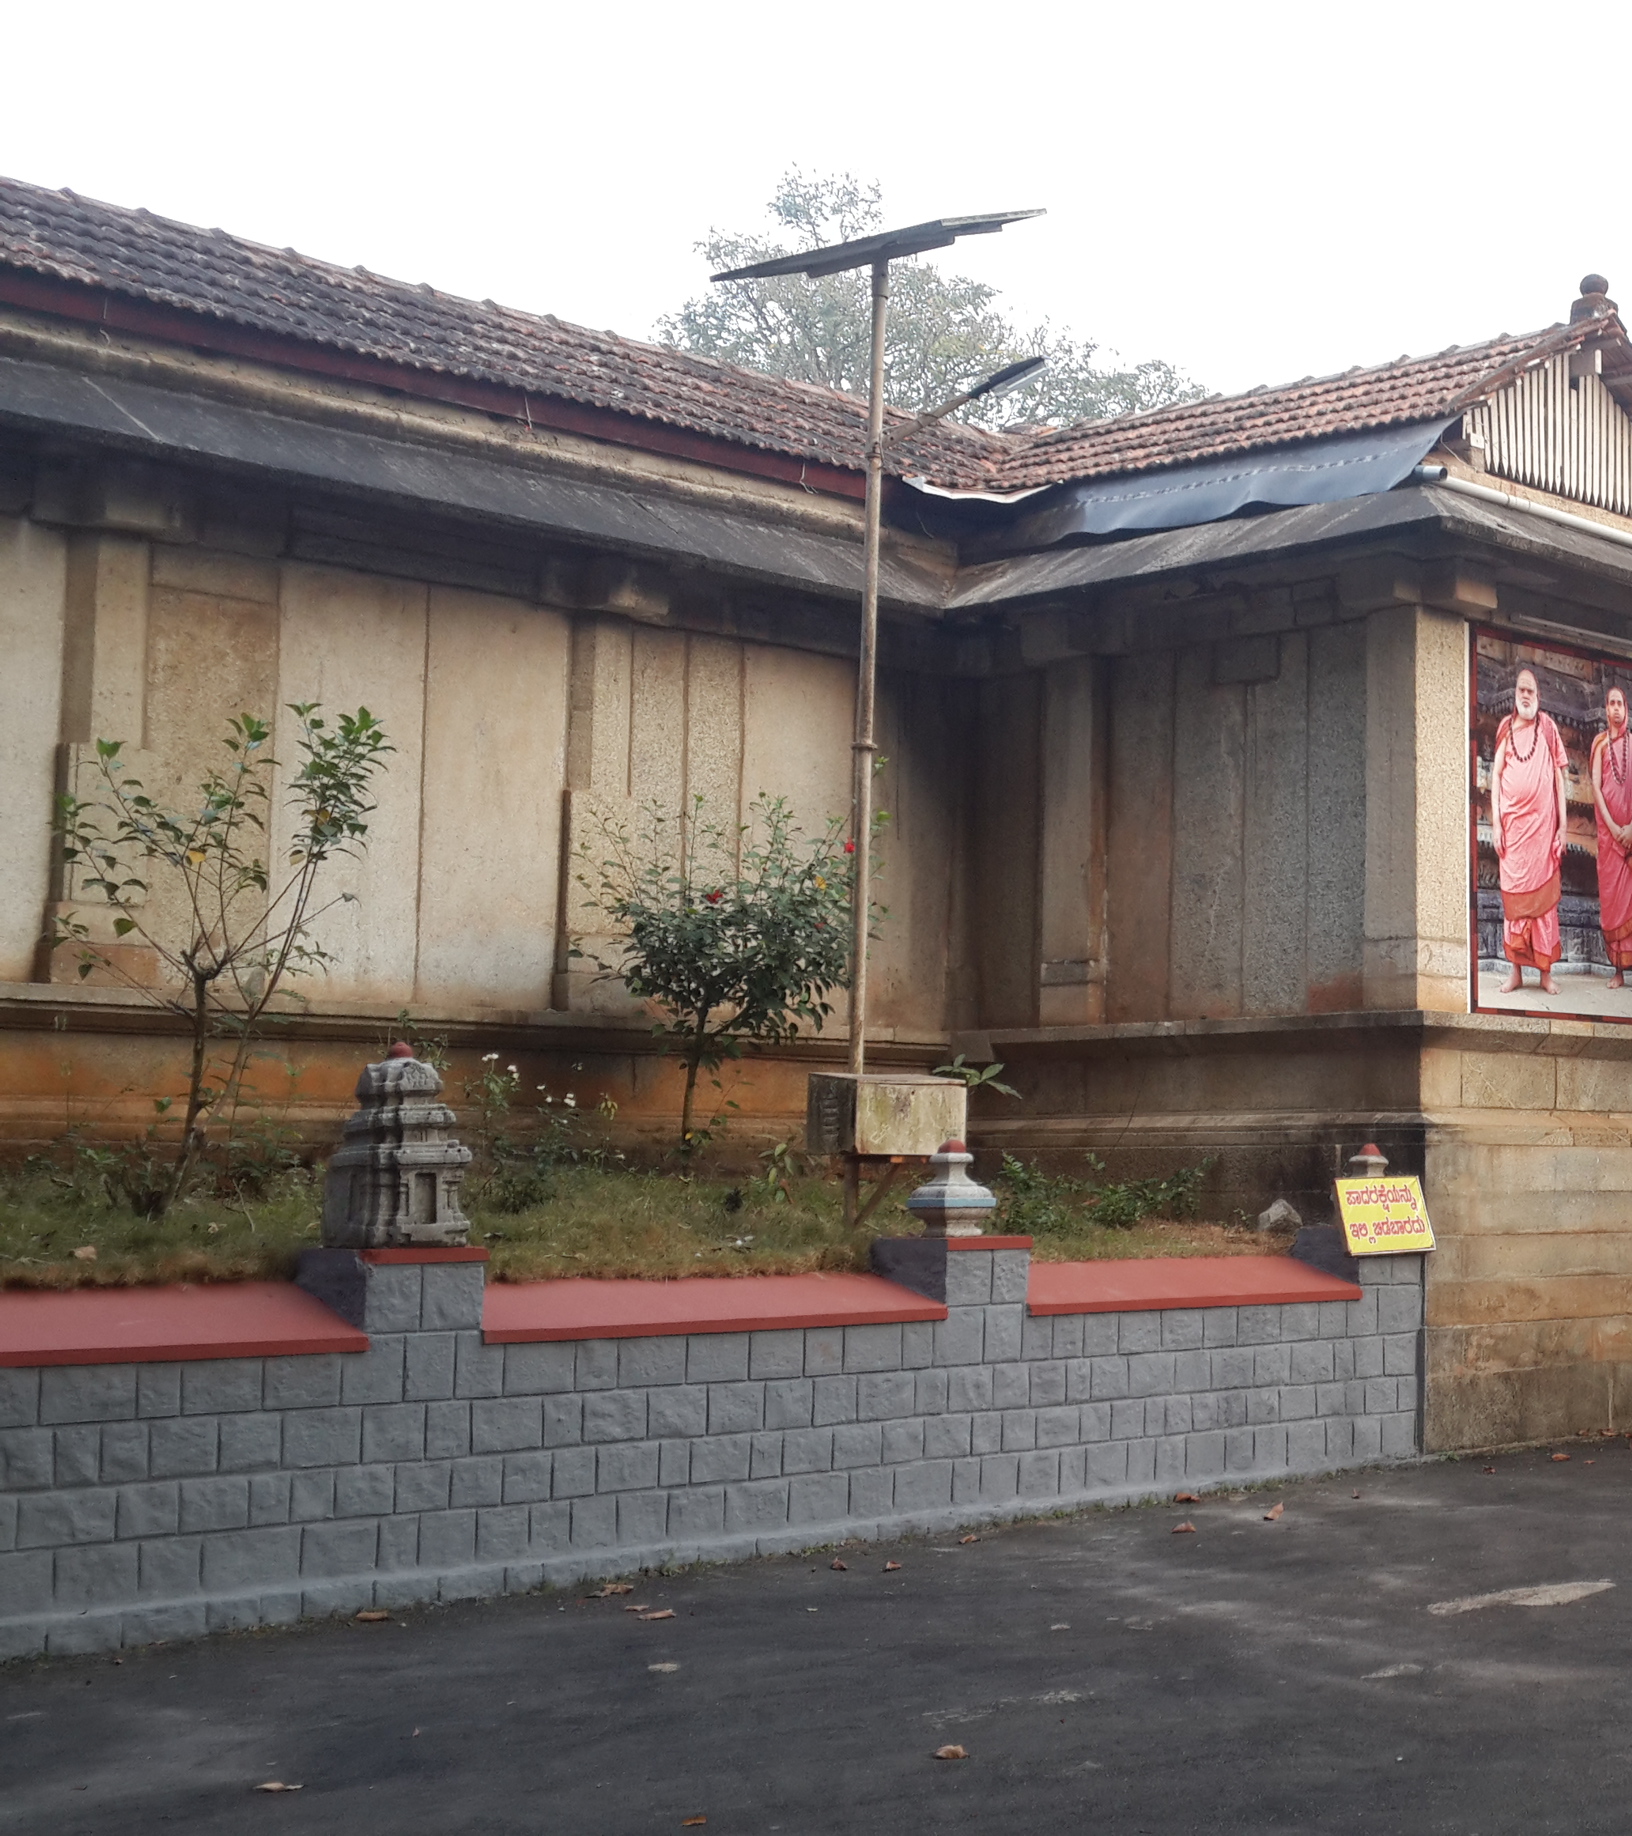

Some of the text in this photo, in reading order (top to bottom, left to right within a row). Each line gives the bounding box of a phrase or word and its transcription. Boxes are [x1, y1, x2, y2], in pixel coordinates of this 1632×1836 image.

[1346, 1184, 1417, 1212] ಪಾದರಕ್ಷೆಯನ್ನು
[1350, 1216, 1426, 1243] ಇಲ್ಲಿ ಬಿಡಬಾರದು
